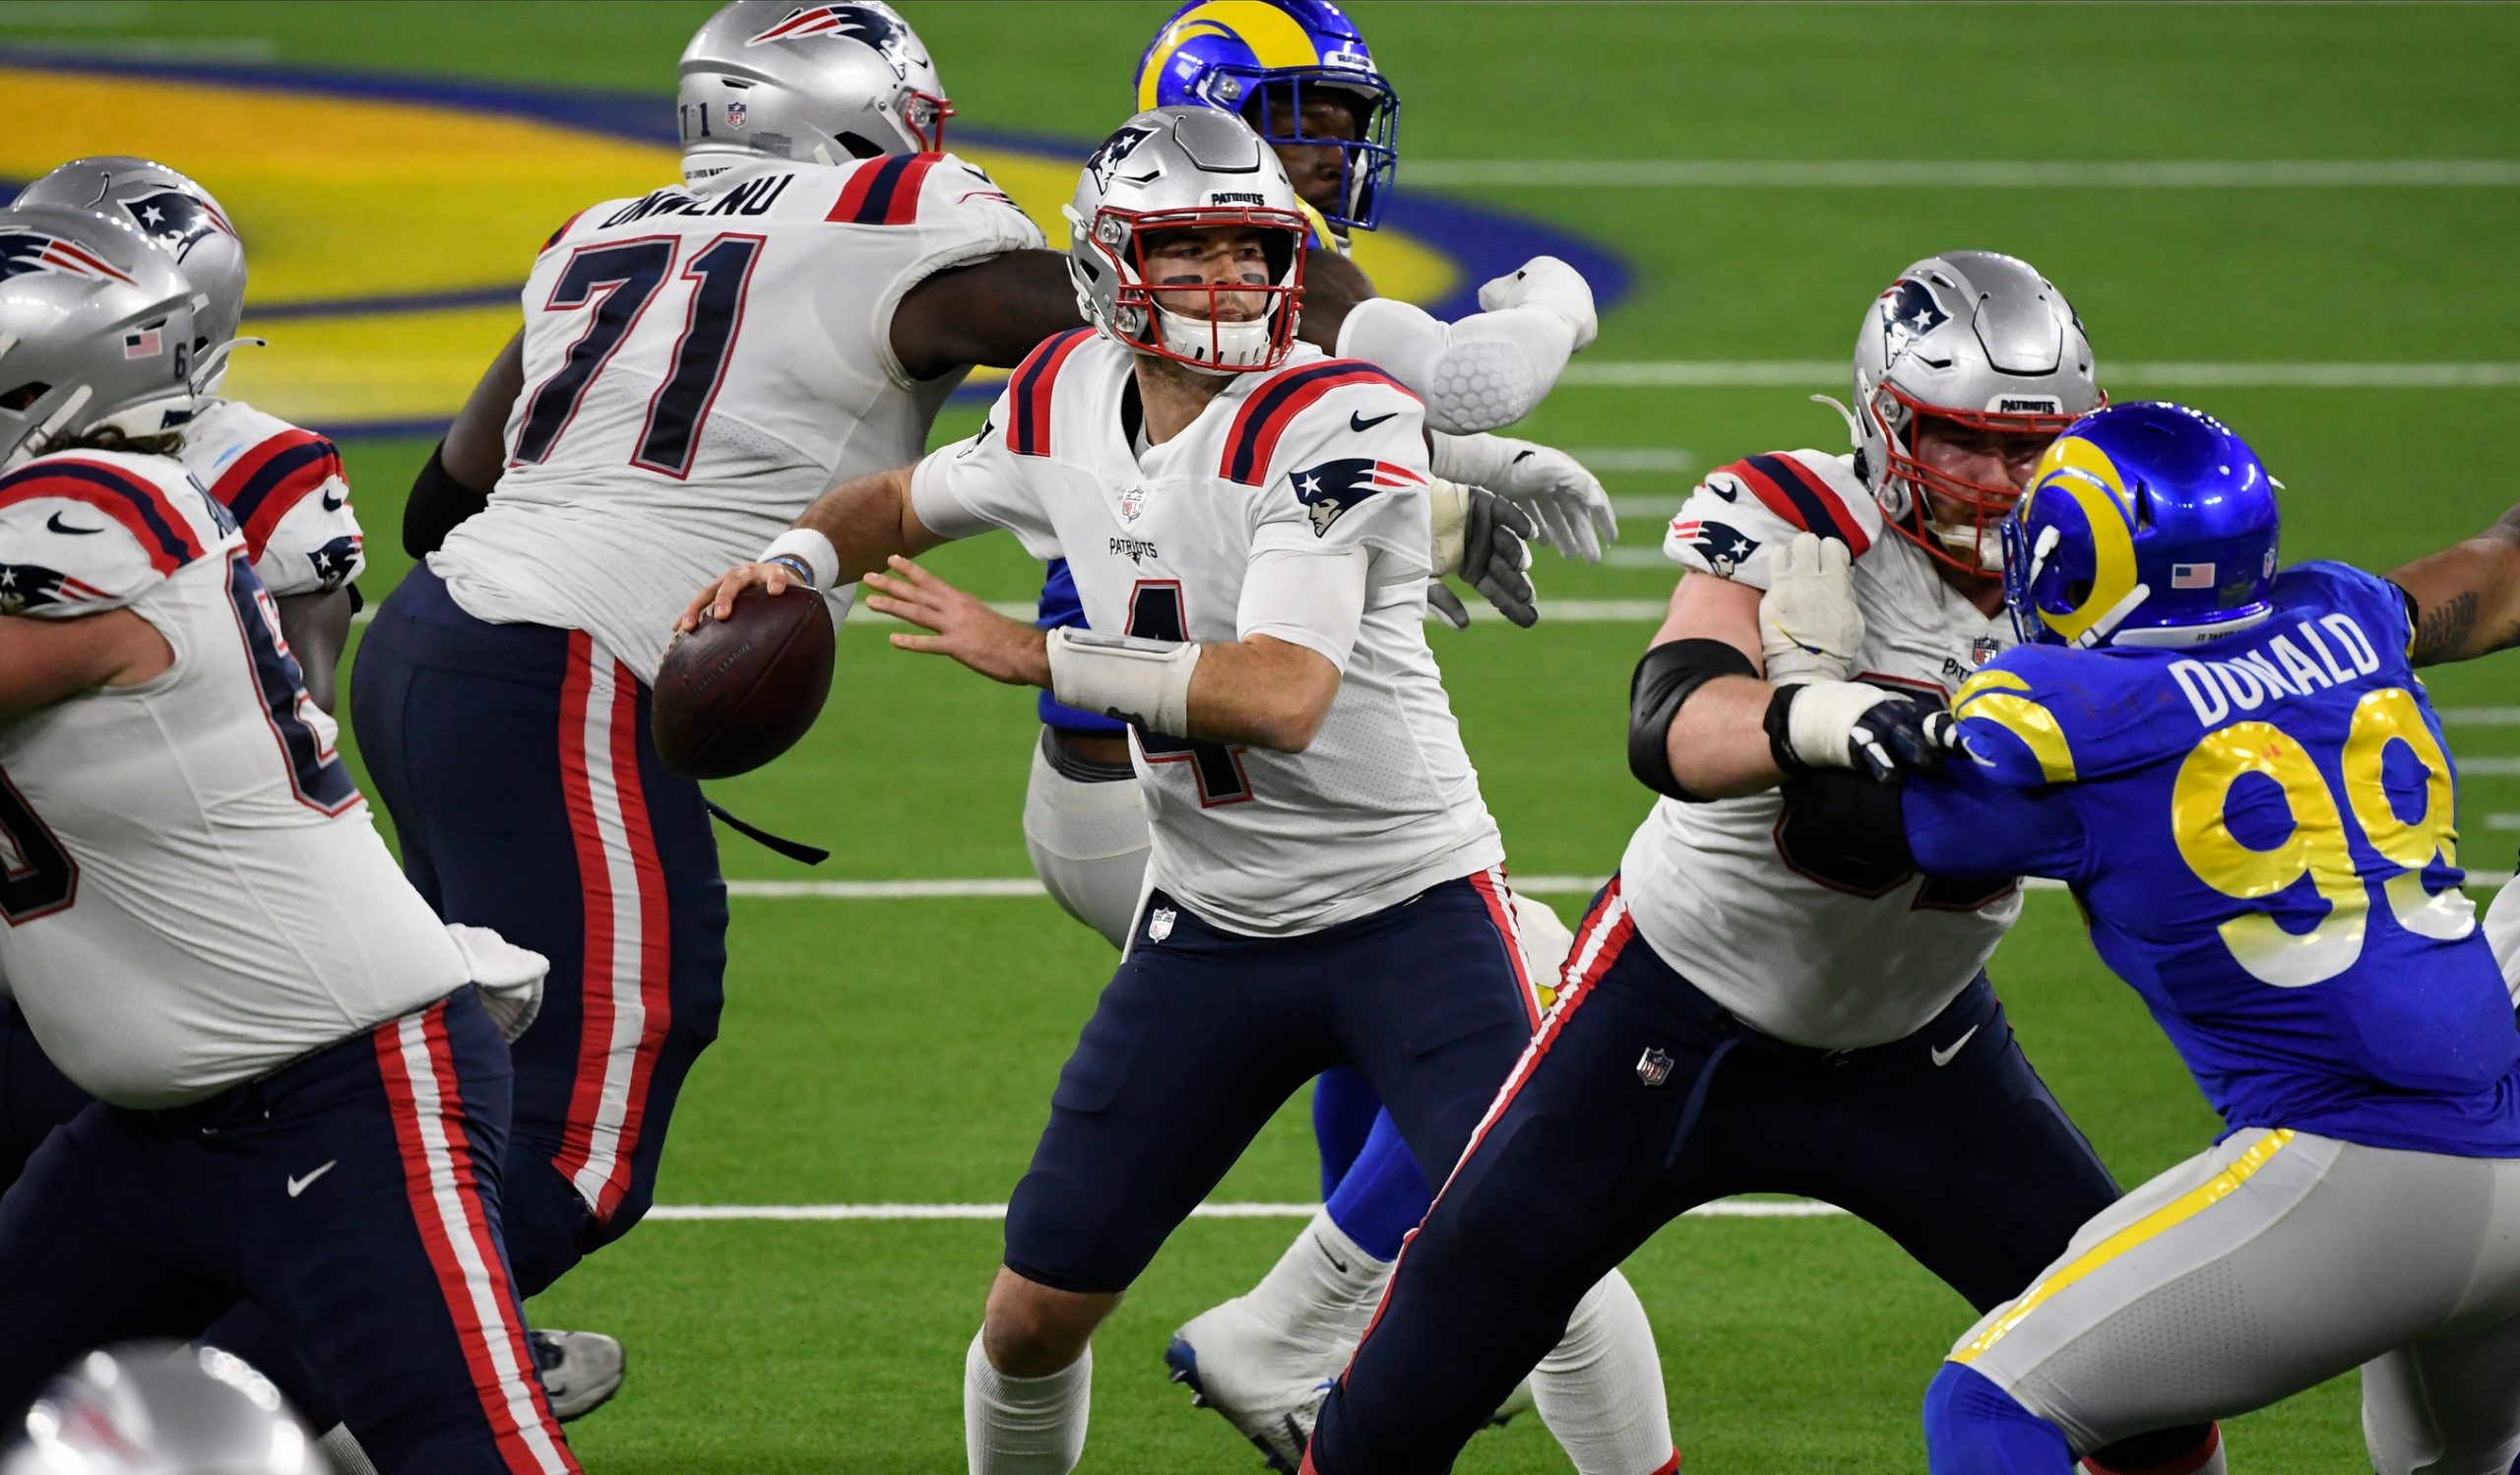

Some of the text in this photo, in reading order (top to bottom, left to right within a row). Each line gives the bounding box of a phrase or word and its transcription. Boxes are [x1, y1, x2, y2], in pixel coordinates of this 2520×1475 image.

[1211, 193, 1265, 207] PATRIOTS
[508, 231, 768, 481] 71
[2000, 399, 2056, 415] PATRIOTS
[1109, 537, 1159, 558] PATRIOTS
[2168, 612, 2380, 728] DONALD
[2172, 687, 2477, 988] 99
